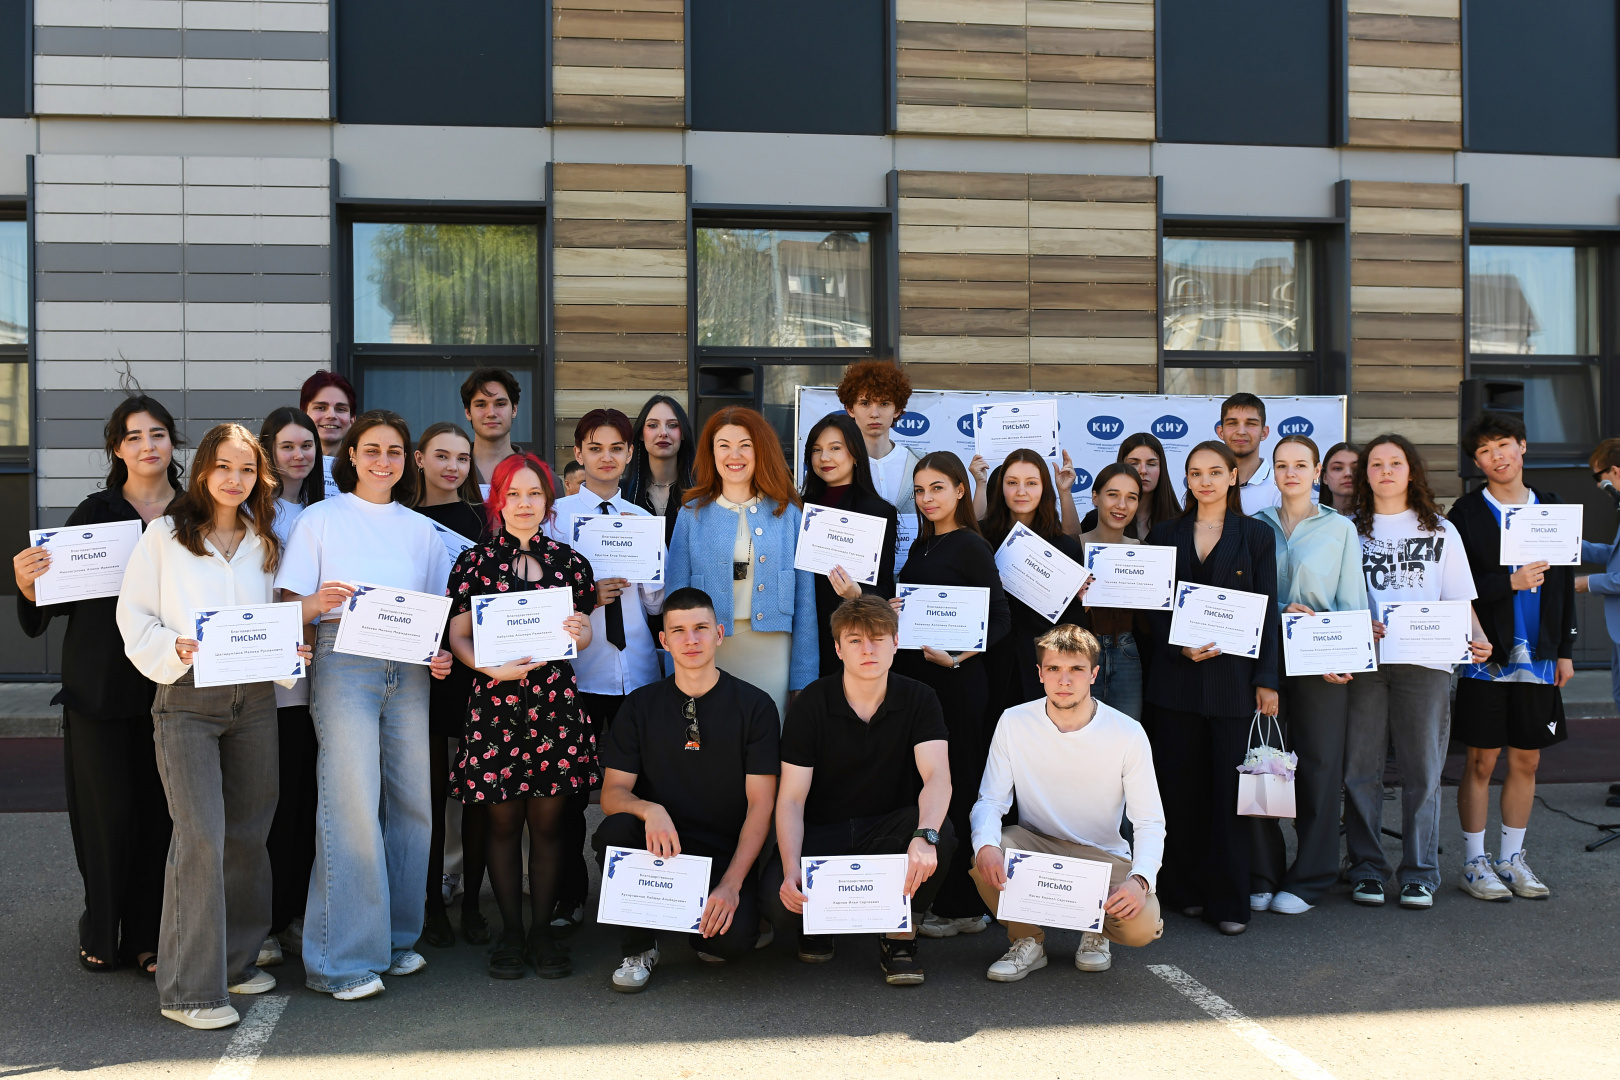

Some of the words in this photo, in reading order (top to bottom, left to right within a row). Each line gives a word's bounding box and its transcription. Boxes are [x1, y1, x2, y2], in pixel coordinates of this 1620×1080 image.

[896, 419, 924, 429] КИУ
[1092, 422, 1119, 432] КИУ
[1156, 423, 1183, 433] КИУ
[1282, 424, 1309, 434] КИУ
[827, 533, 854, 544] ПИСЬМО
[71, 551, 107, 561] ПИСЬМО
[1024, 558, 1051, 579] ПИСЬМО
[378, 613, 412, 624] ПИСЬМО
[1203, 609, 1234, 620] ПИСЬМО
[506, 617, 540, 626] ПИСЬМО
[230, 633, 267, 643] ПИСЬМО
[638, 879, 673, 889] ПИСЬМО
[838, 884, 874, 892] ПИСЬМО
[1037, 880, 1072, 892] ПИСЬМО
